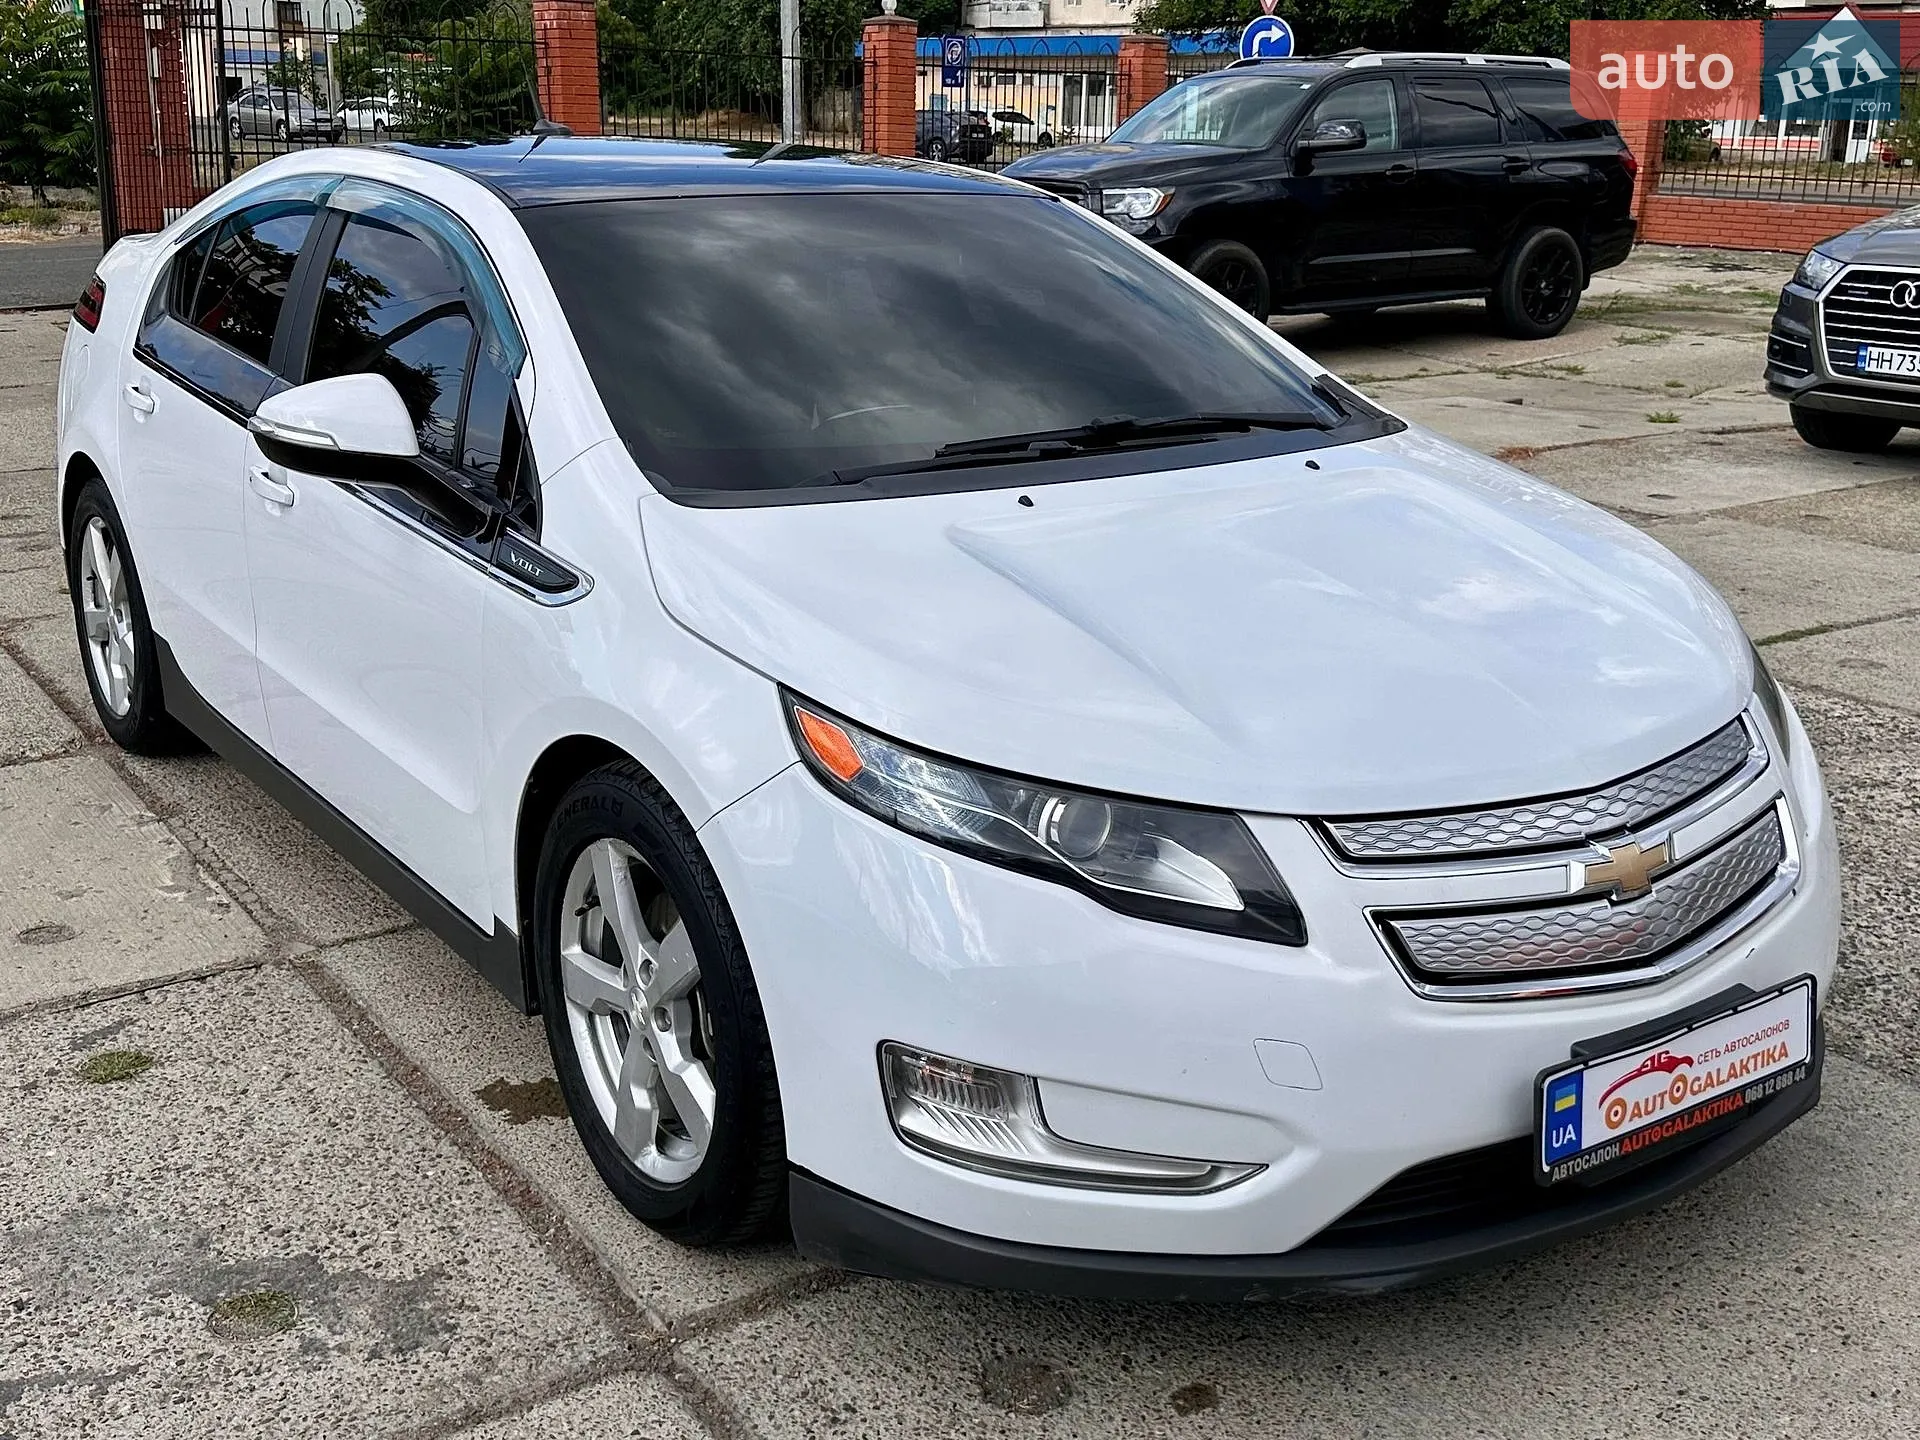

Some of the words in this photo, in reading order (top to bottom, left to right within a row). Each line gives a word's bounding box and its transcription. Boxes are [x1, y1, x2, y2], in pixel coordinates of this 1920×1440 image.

[1867, 350, 1893, 370] HH
[510, 550, 543, 577] VOLT
[1697, 1047, 1721, 1065] СЕТЬ
[1723, 1019, 1790, 1055] АВТОСАЛОНОВ
[1551, 1142, 1620, 1182] АВТОСАЛОН
[1620, 1092, 1745, 1155] AUTOGALAKTIKA
[1764, 1078, 1775, 1095] 12
[1552, 1123, 1577, 1148] UA
